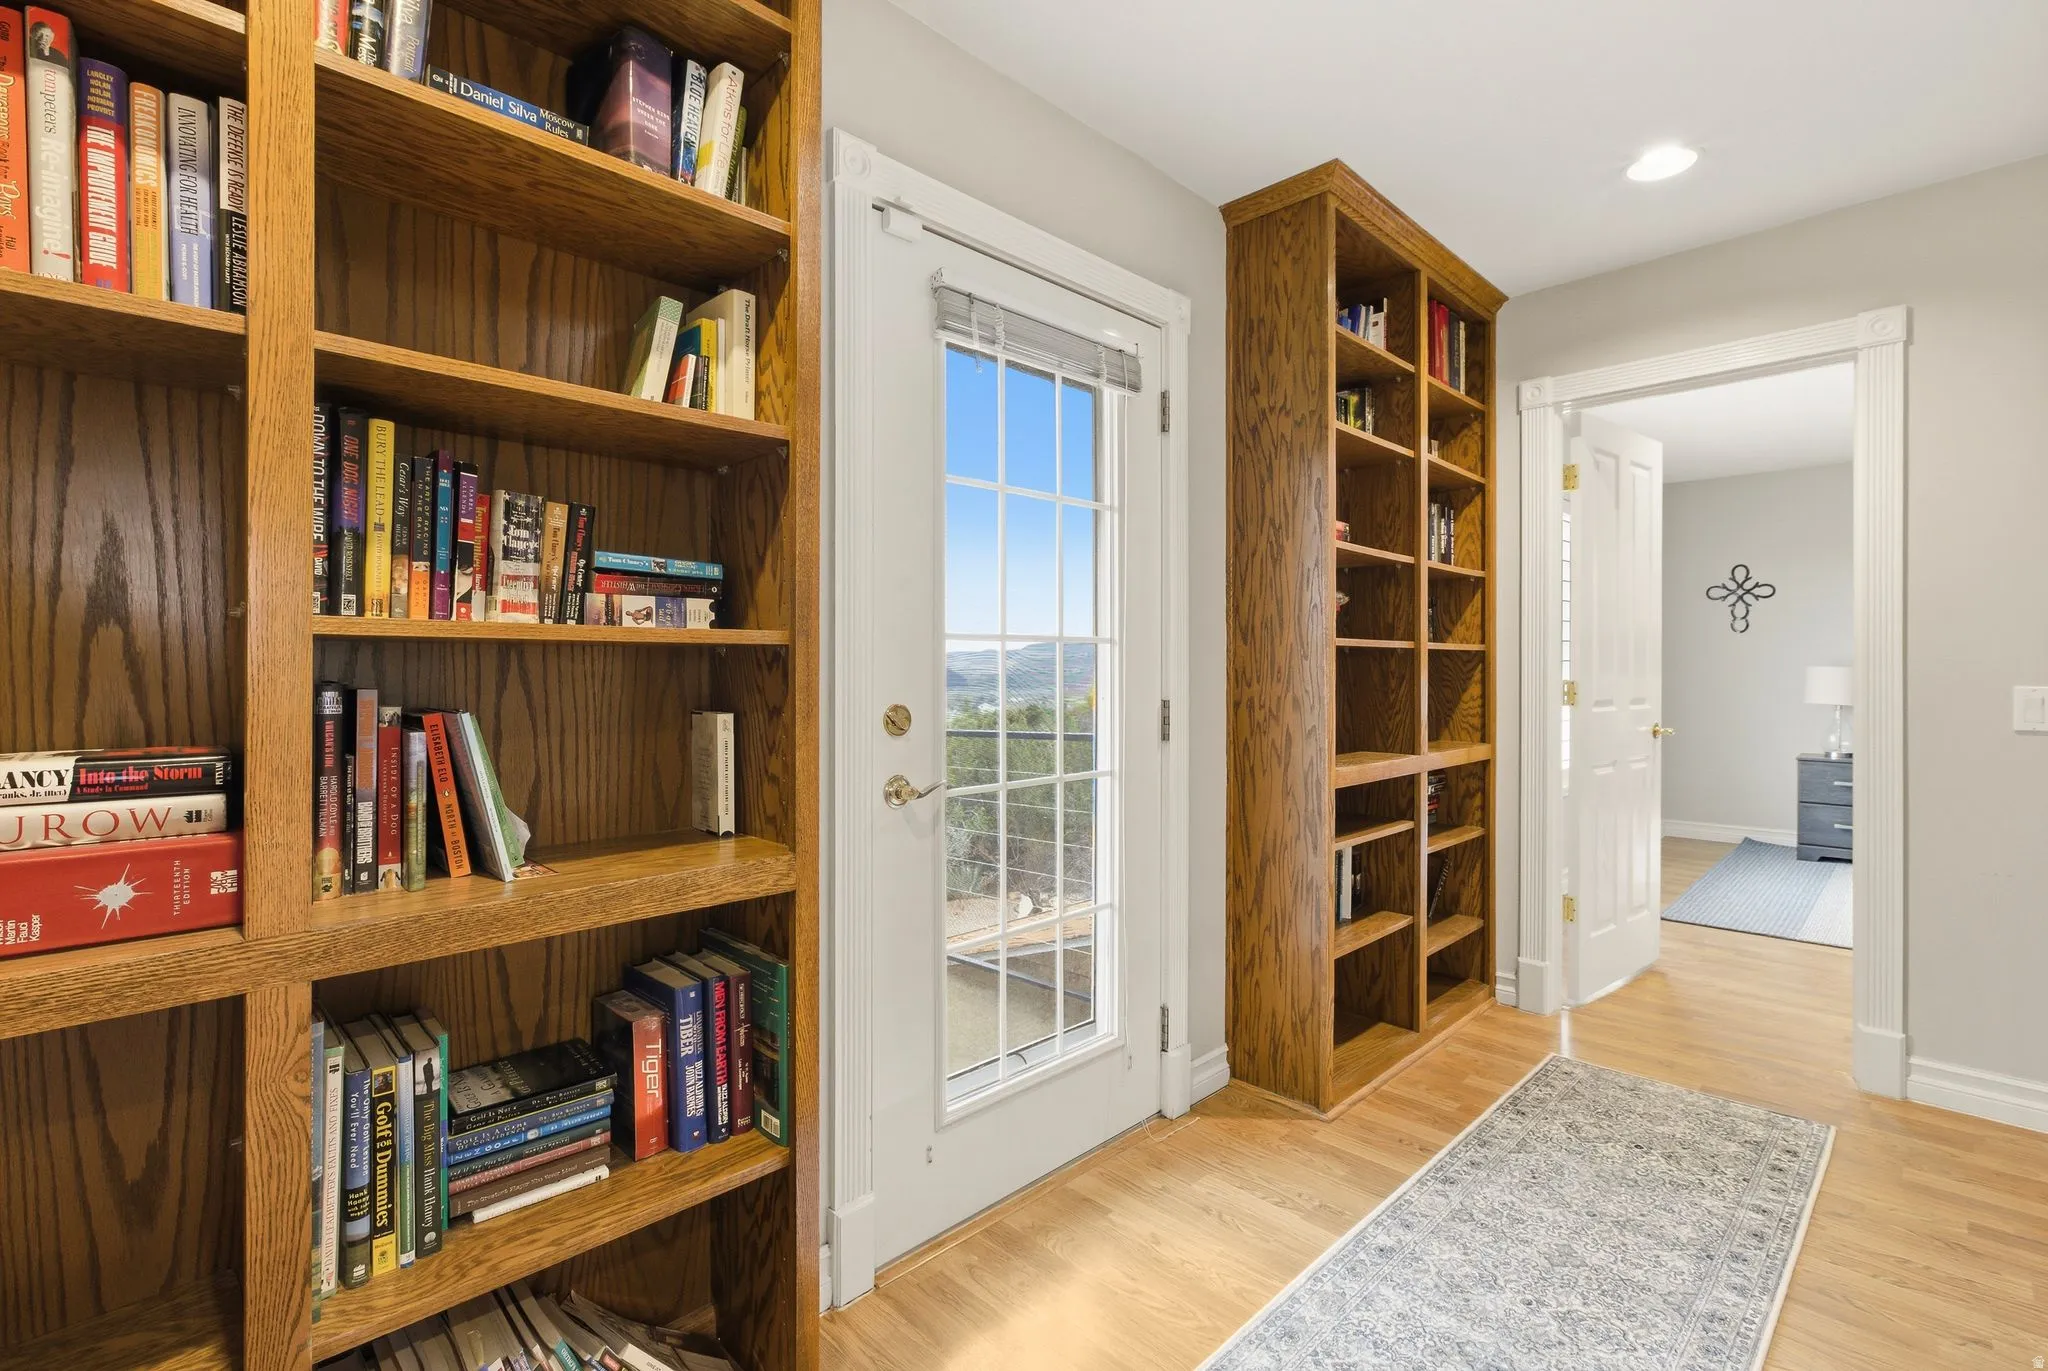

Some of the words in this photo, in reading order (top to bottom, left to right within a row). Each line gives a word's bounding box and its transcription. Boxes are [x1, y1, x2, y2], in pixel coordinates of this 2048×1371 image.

[403, 36, 420, 73] Portrait
[689, 73, 704, 102] BLUE
[723, 75, 739, 120] Atkins
[227, 103, 246, 123] THE
[461, 82, 504, 110] Daniel
[508, 99, 538, 123] Silva
[539, 108, 575, 129] Moscow
[545, 121, 569, 138] Rules
[683, 103, 700, 149] HEAVEN
[720, 119, 732, 140] for
[87, 125, 115, 149] THE
[134, 89, 159, 188] FREAKONOMICS
[178, 107, 197, 173] INNOVATING
[227, 123, 246, 169] DEFENSE
[715, 142, 730, 169] Life
[179, 172, 198, 198] FOR
[228, 168, 245, 182] IS
[36, 136, 72, 260] Re-imagine!
[87, 148, 117, 231] IMPROVEMENT
[228, 181, 245, 212] READY
[179, 198, 199, 236] HEALTH
[5, 235, 16, 251] Hal
[231, 215, 247, 249] LESLIE
[88, 230, 117, 269] GUIDE
[230, 251, 247, 307] ABRAMSON
[743, 314, 751, 334] Draft
[743, 334, 751, 357] Horse
[743, 357, 751, 385] Primer
[313, 414, 326, 456] DOWN
[343, 434, 360, 459] ONE
[375, 424, 387, 457] BURY
[313, 457, 326, 476] TO
[343, 461, 360, 486] DOG
[375, 459, 387, 485] THE
[397, 461, 410, 493] Cesar's
[313, 478, 325, 506] THE
[417, 479, 423, 489] IN
[343, 486, 359, 524] NIGHT
[375, 485, 387, 516] LEAD
[395, 497, 408, 517] Way
[423, 505, 430, 516] OF
[313, 507, 325, 542] WIRE
[314, 556, 323, 576] DAVID
[575, 558, 587, 588] Op-Center
[608, 556, 622, 564] Tom
[623, 557, 649, 568] Clancy's
[602, 665, 626, 674] yoga
[391, 747, 399, 781] INSIDE
[430, 724, 446, 765] ELISABETH
[438, 768, 448, 783] ELO
[0, 769, 69, 789] ANCY
[79, 766, 115, 785] Into
[121, 763, 148, 781] the
[153, 764, 202, 781] Storm
[83, 785, 103, 793] Study
[113, 782, 148, 793] Command
[329, 774, 338, 801] HAROLD
[319, 776, 328, 807] BARRETT
[391, 787, 398, 797] OF
[319, 808, 328, 838] TILLMAN
[330, 802, 338, 825] COYLE
[356, 801, 373, 819] BAND
[390, 814, 399, 836] DOG
[445, 803, 456, 829] NORTH
[451, 840, 465, 871] BOSTON
[356, 827, 373, 864] BROTHERS
[173, 860, 181, 916] THIRTEENTH
[5, 919, 16, 945] Martin
[28, 913, 43, 942] Kasper
[714, 981, 726, 1009] MEN
[680, 1014, 694, 1058] TIBER
[715, 1010, 727, 1045] FROM
[642, 1038, 662, 1099] Tiger
[685, 1064, 695, 1085] JOHN
[694, 1059, 703, 1081] BUZZ
[716, 1046, 728, 1085] EARTH
[328, 1087, 338, 1112] FIXES
[350, 1091, 360, 1117] You'll
[685, 1085, 696, 1117] BARNES
[694, 1080, 703, 1107] ALDRIN
[360, 1098, 372, 1119] Only
[376, 1101, 393, 1138] Golf
[423, 1101, 436, 1122] The
[470, 1110, 488, 1122] Golf
[328, 1114, 337, 1135] AND
[350, 1121, 360, 1143] Ever
[420, 1123, 436, 1141] Big
[327, 1136, 337, 1170] FAULTS
[350, 1146, 360, 1169] Need
[424, 1143, 436, 1166] Miss
[349, 1189, 367, 1199] Hank
[375, 1148, 393, 1228] Dummies
[423, 1166, 436, 1195] Hank
[326, 1171, 335, 1235] LEADBETTER'S
[347, 1195, 370, 1206] Haney
[421, 1197, 436, 1228] Haney
[325, 1237, 334, 1268] DAVID
